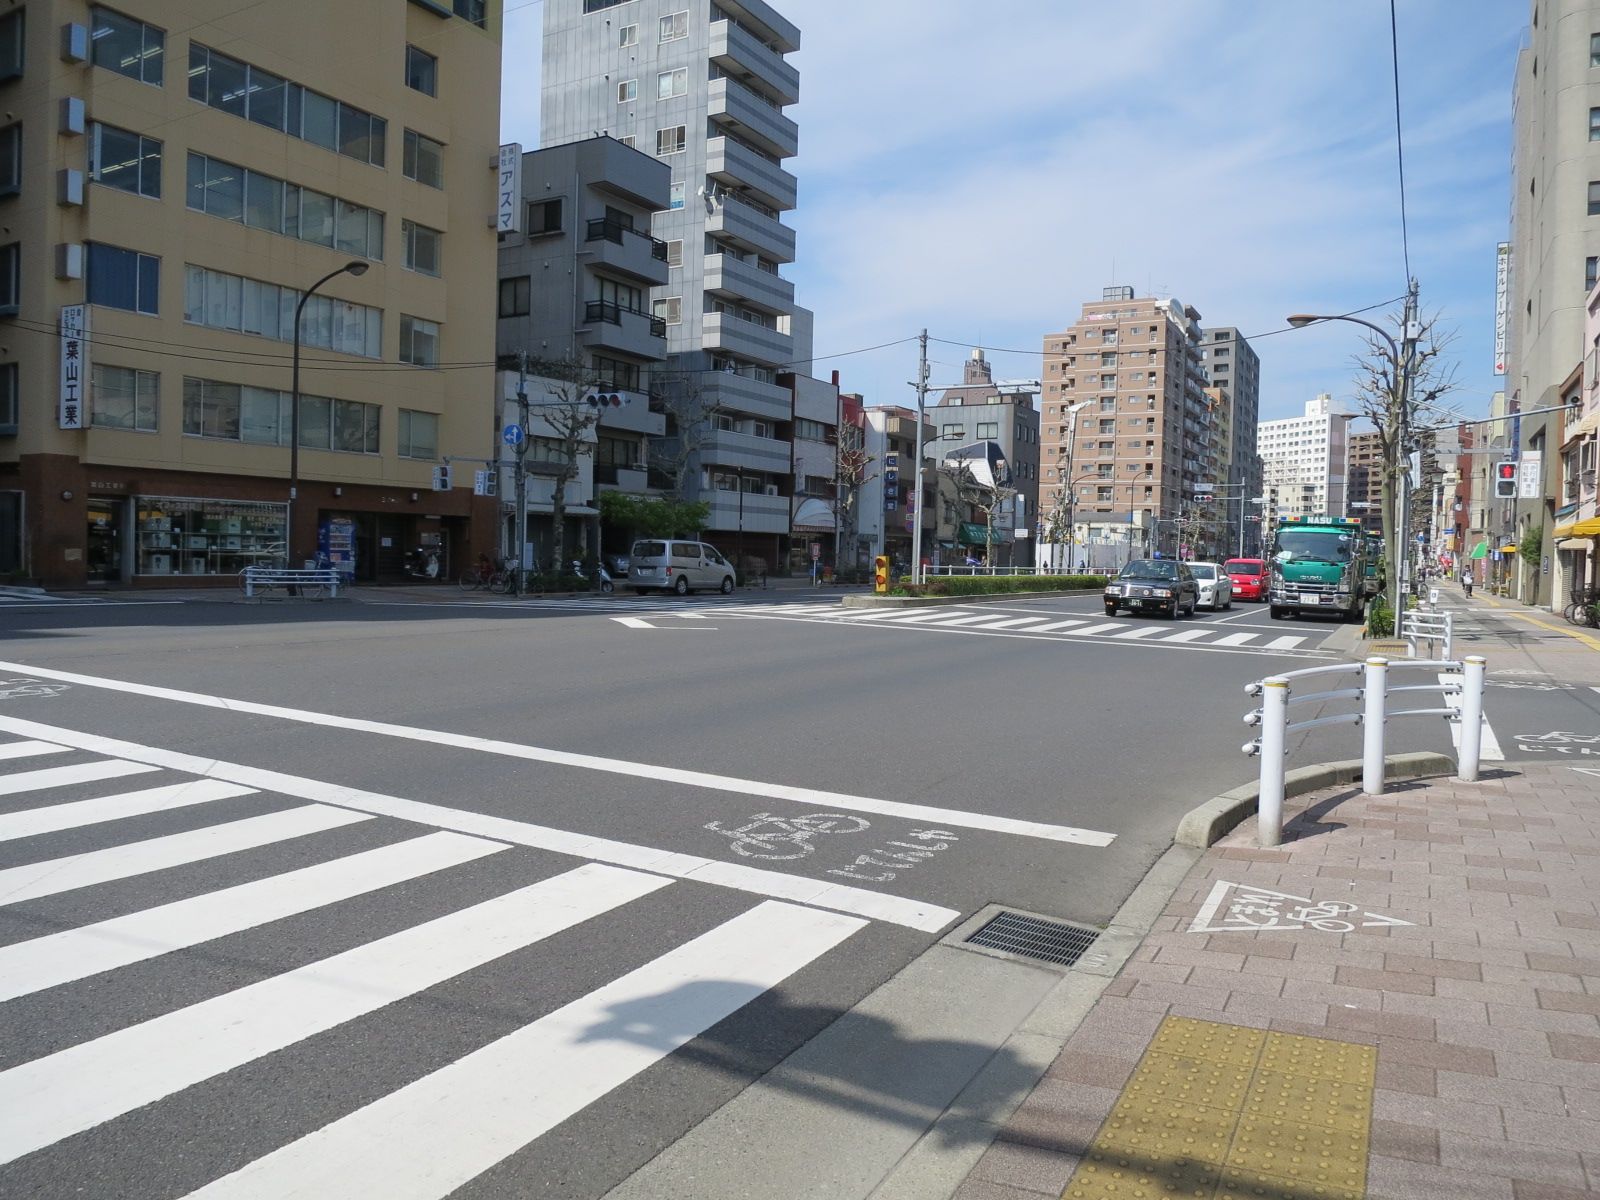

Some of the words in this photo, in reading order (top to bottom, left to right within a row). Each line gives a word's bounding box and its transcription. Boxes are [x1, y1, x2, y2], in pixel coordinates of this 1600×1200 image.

[500, 170, 513, 228] アズマ
[65, 340, 79, 425] 葉山工業
[1307, 516, 1333, 524] NASU
[1223, 894, 1286, 927] とまれ
